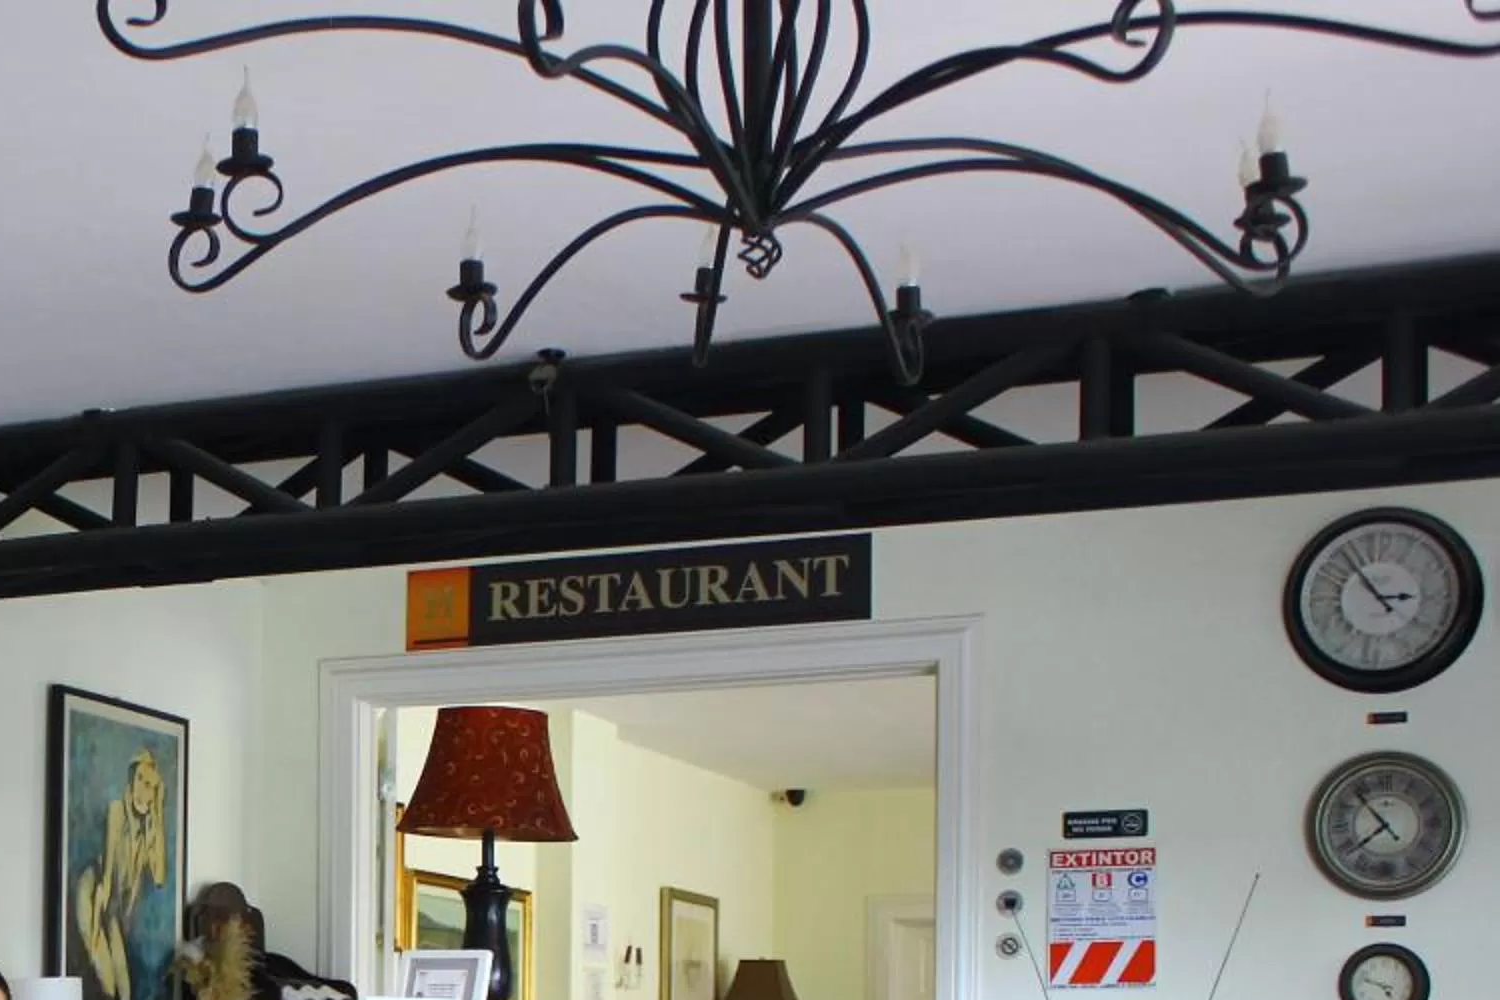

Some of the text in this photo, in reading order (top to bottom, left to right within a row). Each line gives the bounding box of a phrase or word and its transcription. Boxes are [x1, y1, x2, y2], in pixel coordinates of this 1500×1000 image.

[488, 555, 849, 622] RESTAURANT
[1052, 850, 1154, 867] EXTINTOR
[1131, 873, 1144, 887] C
